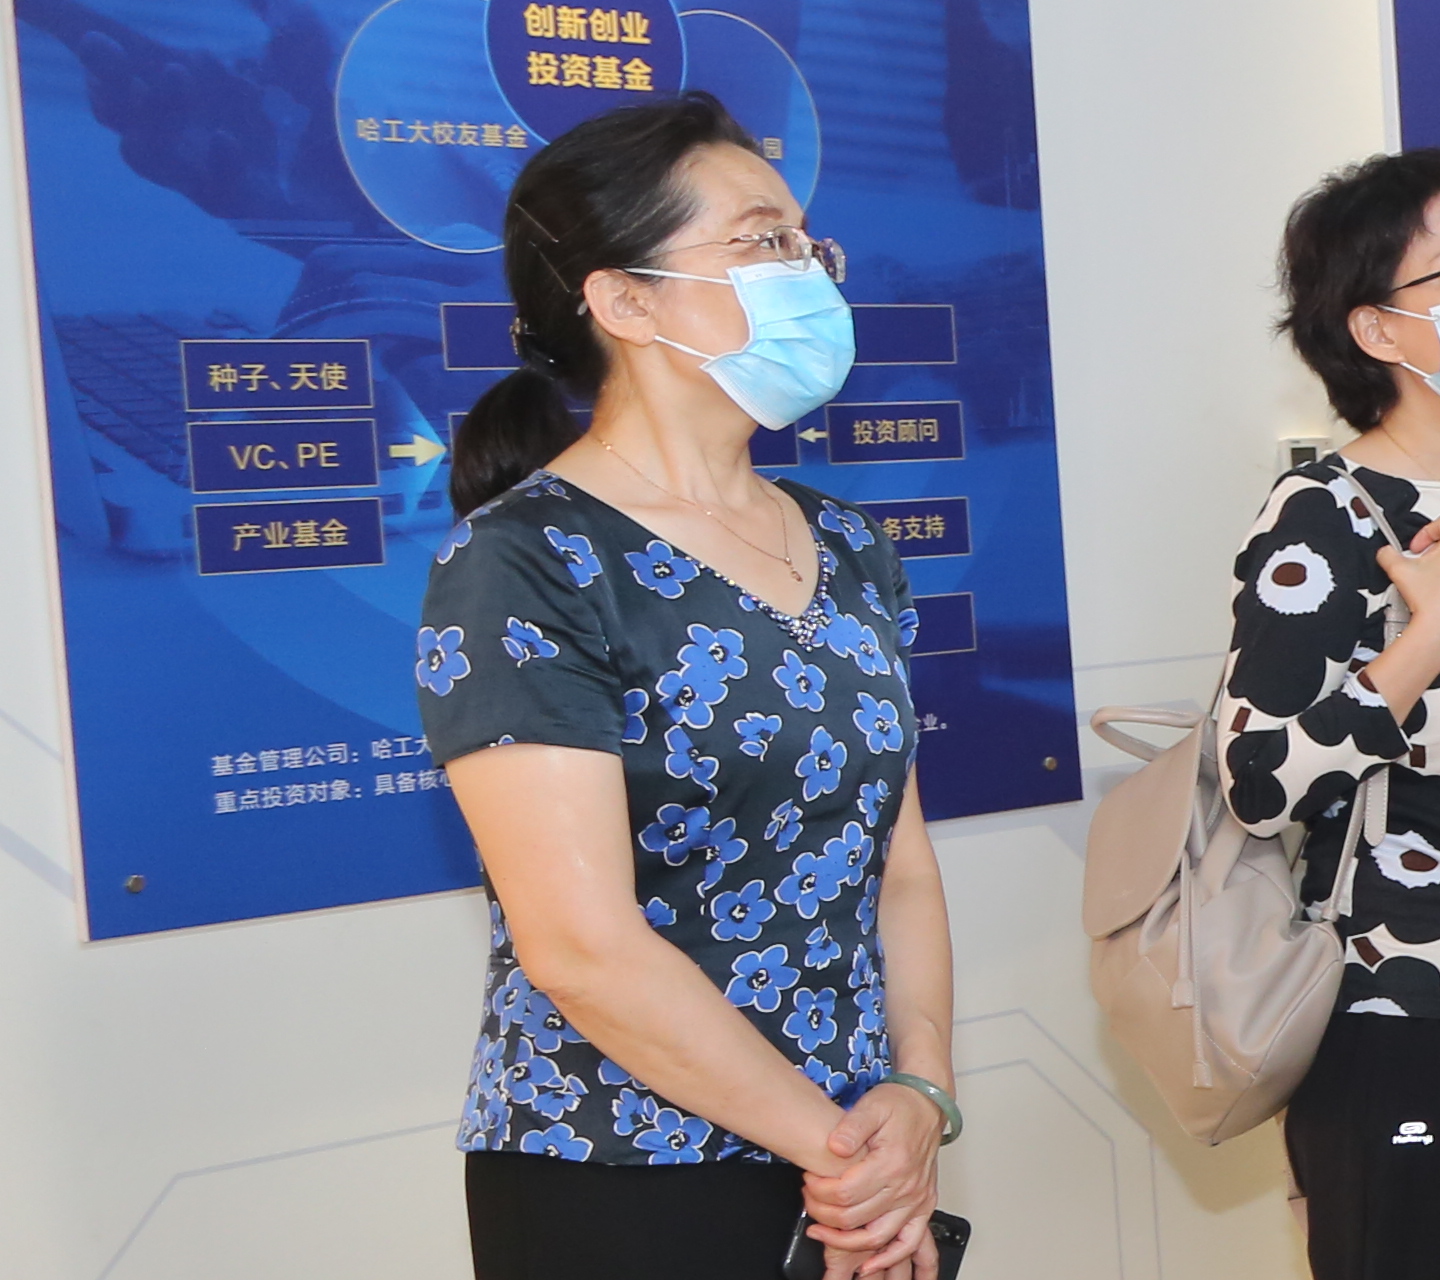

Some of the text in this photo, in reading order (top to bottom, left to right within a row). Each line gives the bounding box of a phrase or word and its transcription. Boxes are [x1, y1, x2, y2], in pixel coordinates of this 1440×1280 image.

[523, 3, 651, 46] 创新创业
[527, 52, 653, 91] 投资基金
[356, 118, 529, 149] 哈工大校友基金
[209, 363, 348, 392] 种子、天使
[853, 418, 939, 444] 投资顾问
[233, 519, 348, 552] 产业基金
[878, 514, 946, 542] 务支持
